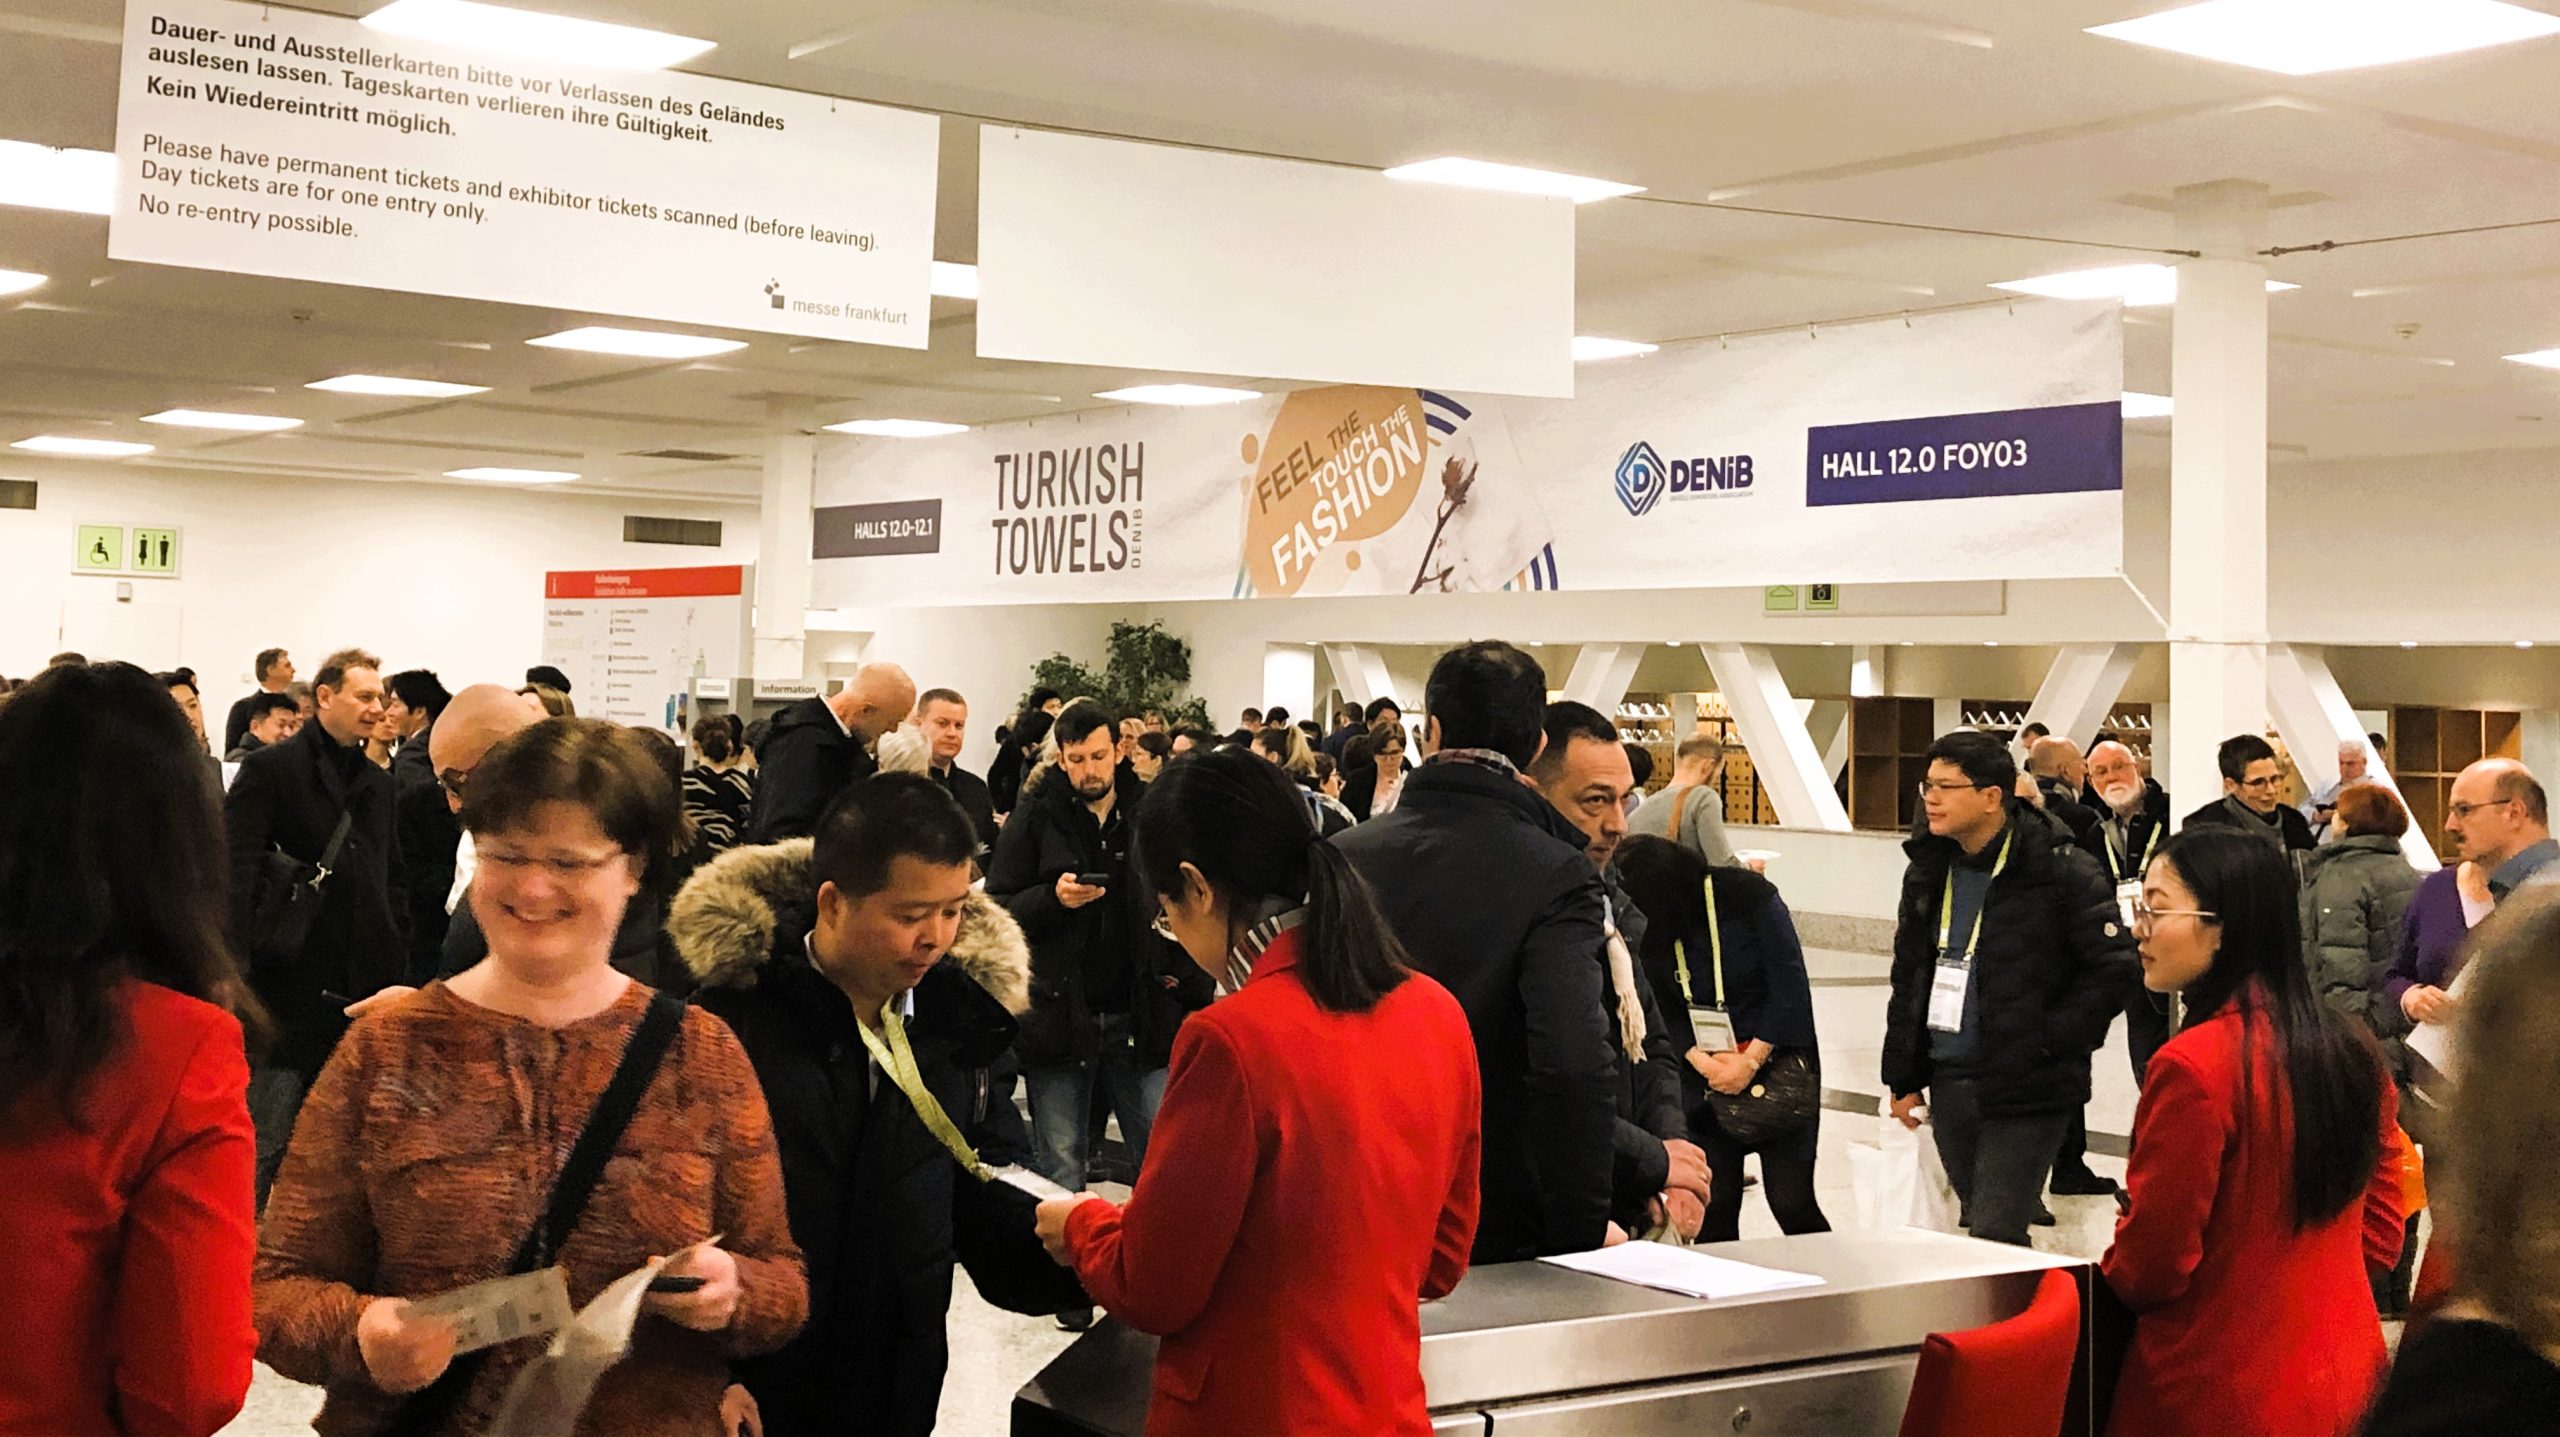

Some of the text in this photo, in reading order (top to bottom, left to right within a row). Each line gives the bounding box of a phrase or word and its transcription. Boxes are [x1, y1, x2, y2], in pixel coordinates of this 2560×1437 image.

[148, 47, 713, 143] auslesen lassen. Tageskarten verlieren ihre Gültigkeit.
[151, 15, 785, 131] Dauer- und Ausstellerkarten bitte vor Verlassen des Geländes
[147, 75, 457, 137] Kein Wiedereintritt möglich.
[139, 193, 358, 238] No re-entry possible.
[142, 160, 489, 224] Day tickets are for one entry only.
[144, 134, 879, 252] Please have permanent tickets and exhibitor tickets scanned (before leaving).
[792, 301, 908, 325] messe frankfurt
[994, 441, 1144, 511] TURKISH
[1256, 409, 1362, 515] FEEL THE
[1309, 403, 1410, 497] TOUCH THE
[1822, 440, 2029, 479] HALL 12.0 FOY03
[854, 516, 933, 540] HALLS 12.0-12.1
[1270, 421, 1423, 586] FASHION
[992, 510, 1129, 575] TOWELS
[761, 684, 817, 694] information
